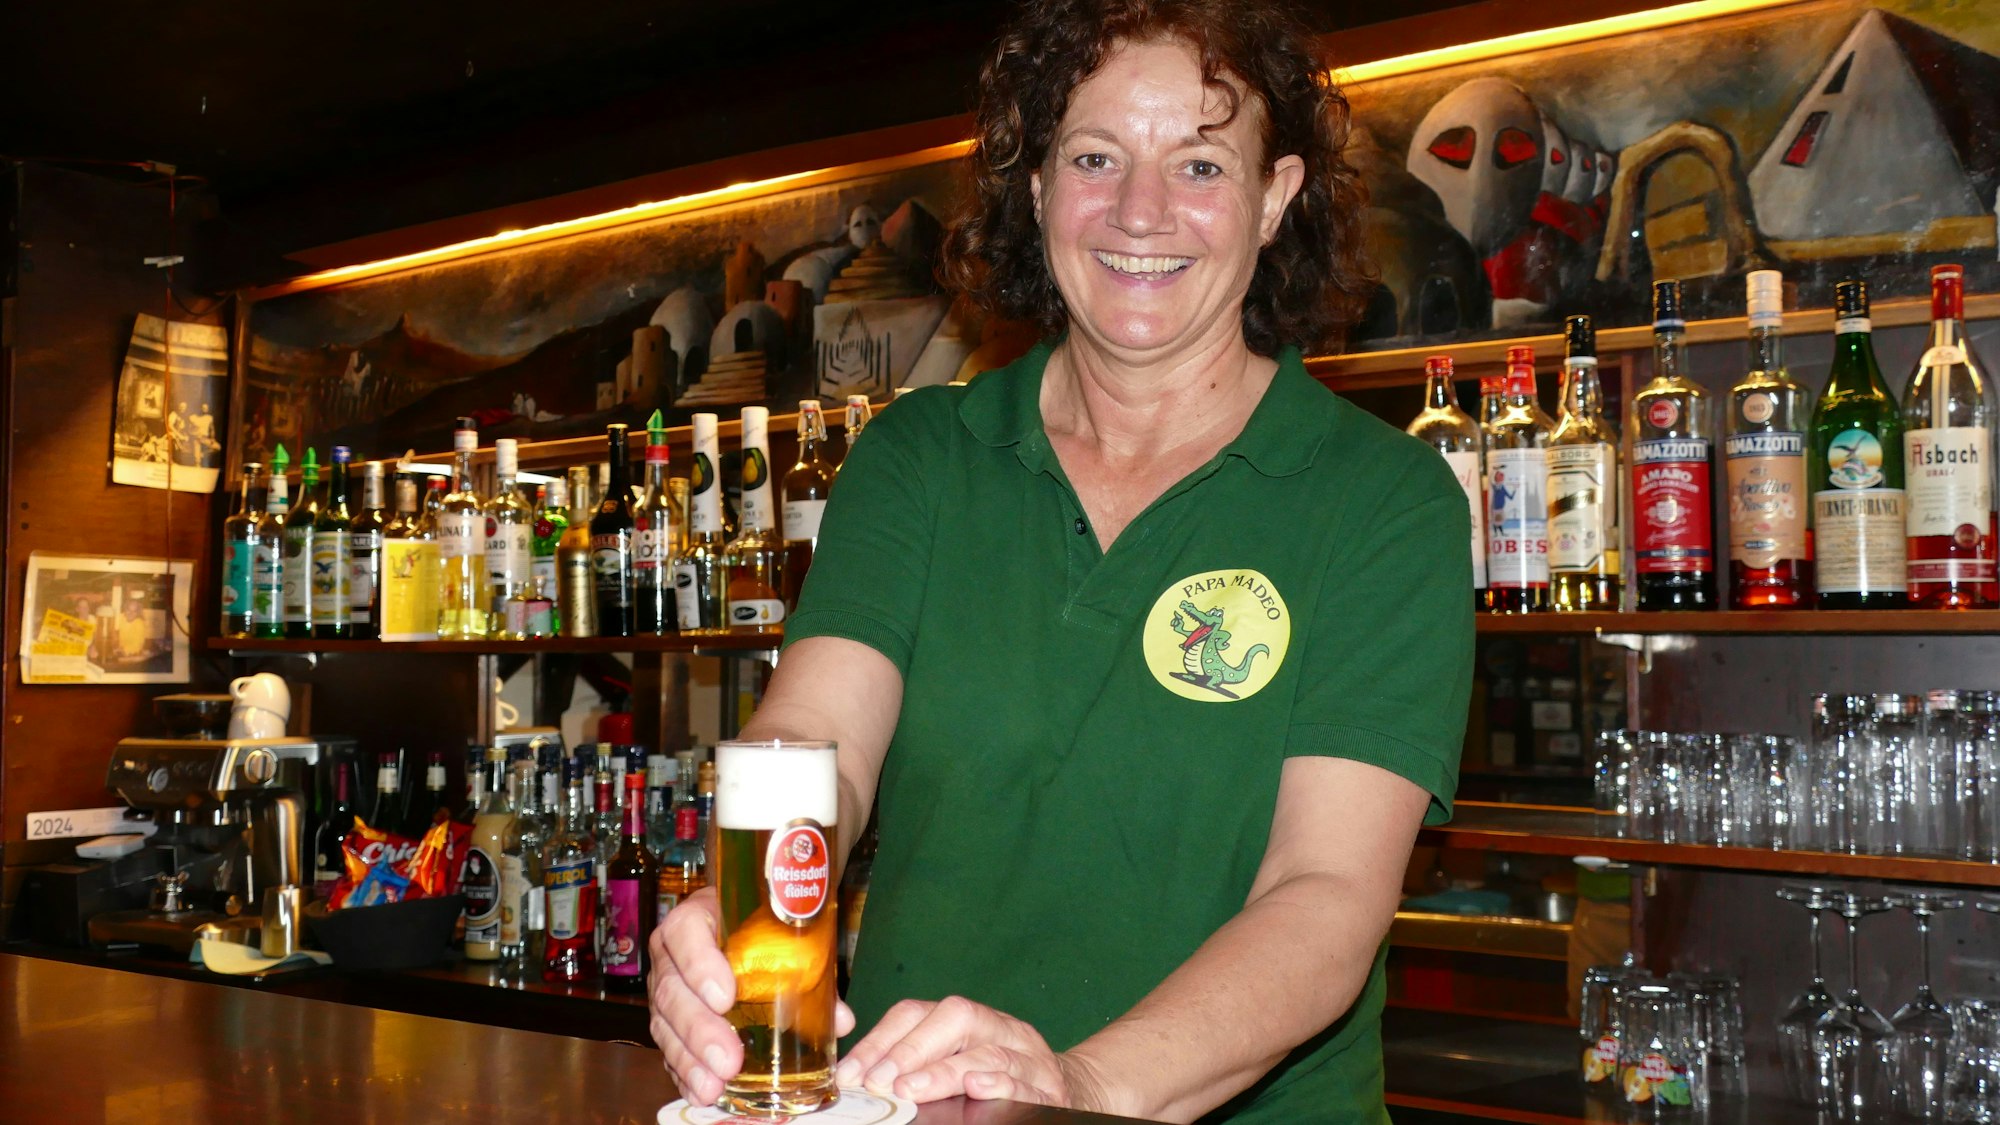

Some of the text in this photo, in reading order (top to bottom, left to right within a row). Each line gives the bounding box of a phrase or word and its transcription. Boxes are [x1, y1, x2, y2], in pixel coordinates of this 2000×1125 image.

[1910, 441, 1979, 469] Asbach
[1640, 467, 1693, 485] AMARO
[1926, 468, 1955, 478] URAL
[1492, 538, 1549, 555] OBES
[1182, 574, 1281, 621] PAPA MADEO
[33, 818, 73, 836] 2024
[545, 868, 586, 888] APEROL
[773, 865, 828, 882] Reissdorf
[784, 883, 820, 899] Kölsch
